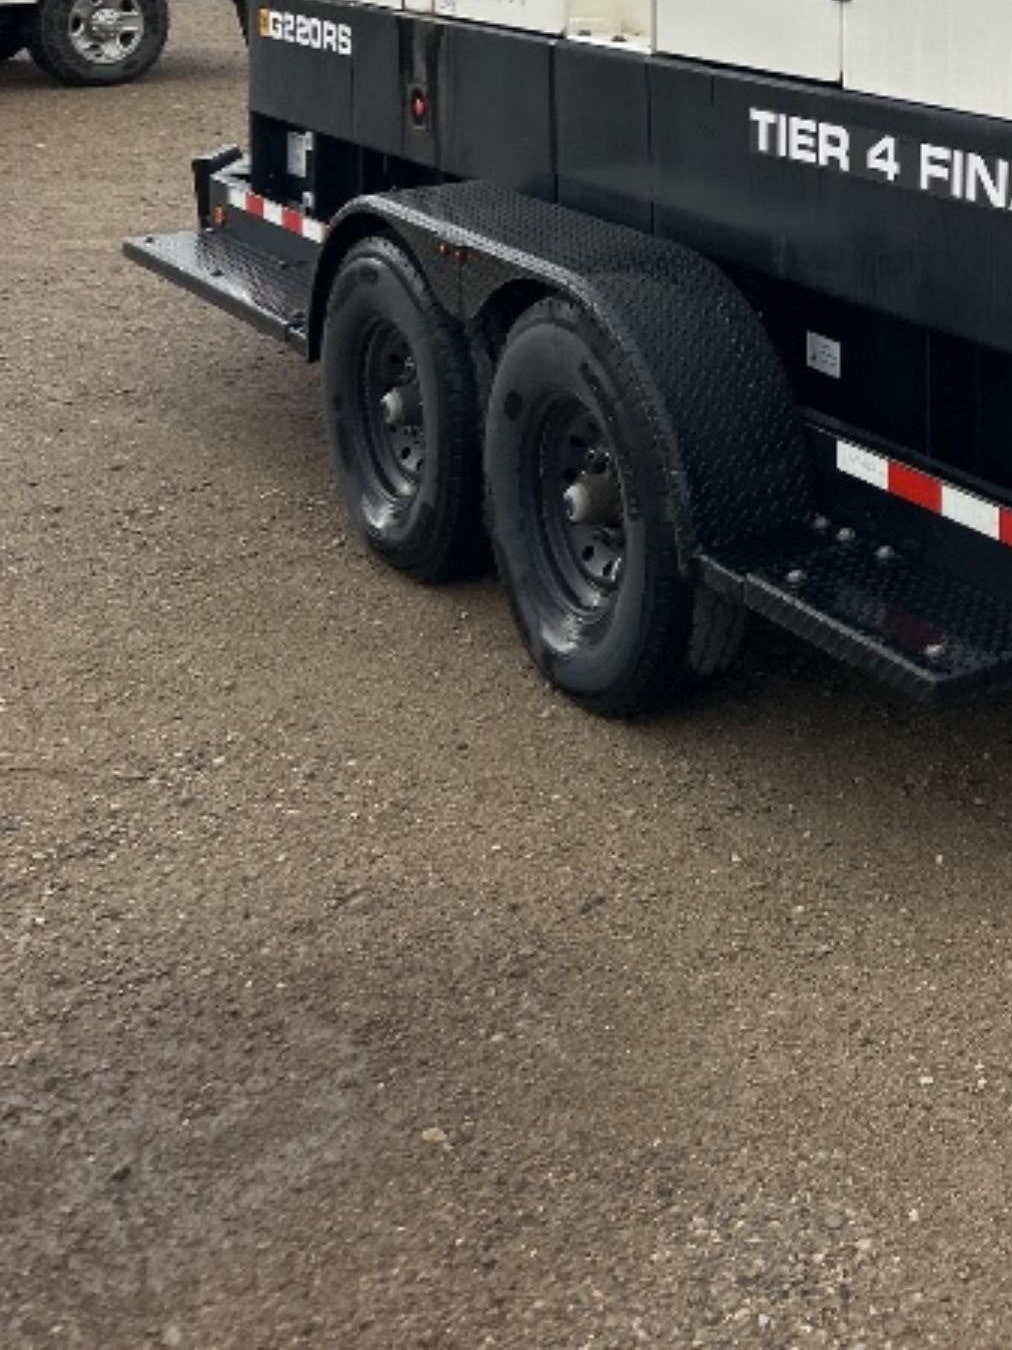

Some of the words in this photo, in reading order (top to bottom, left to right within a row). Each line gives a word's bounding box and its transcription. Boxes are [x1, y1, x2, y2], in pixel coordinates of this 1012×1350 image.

[269, 10, 352, 55] G220RS
[750, 108, 850, 172] TIER
[866, 134, 900, 182] 4
